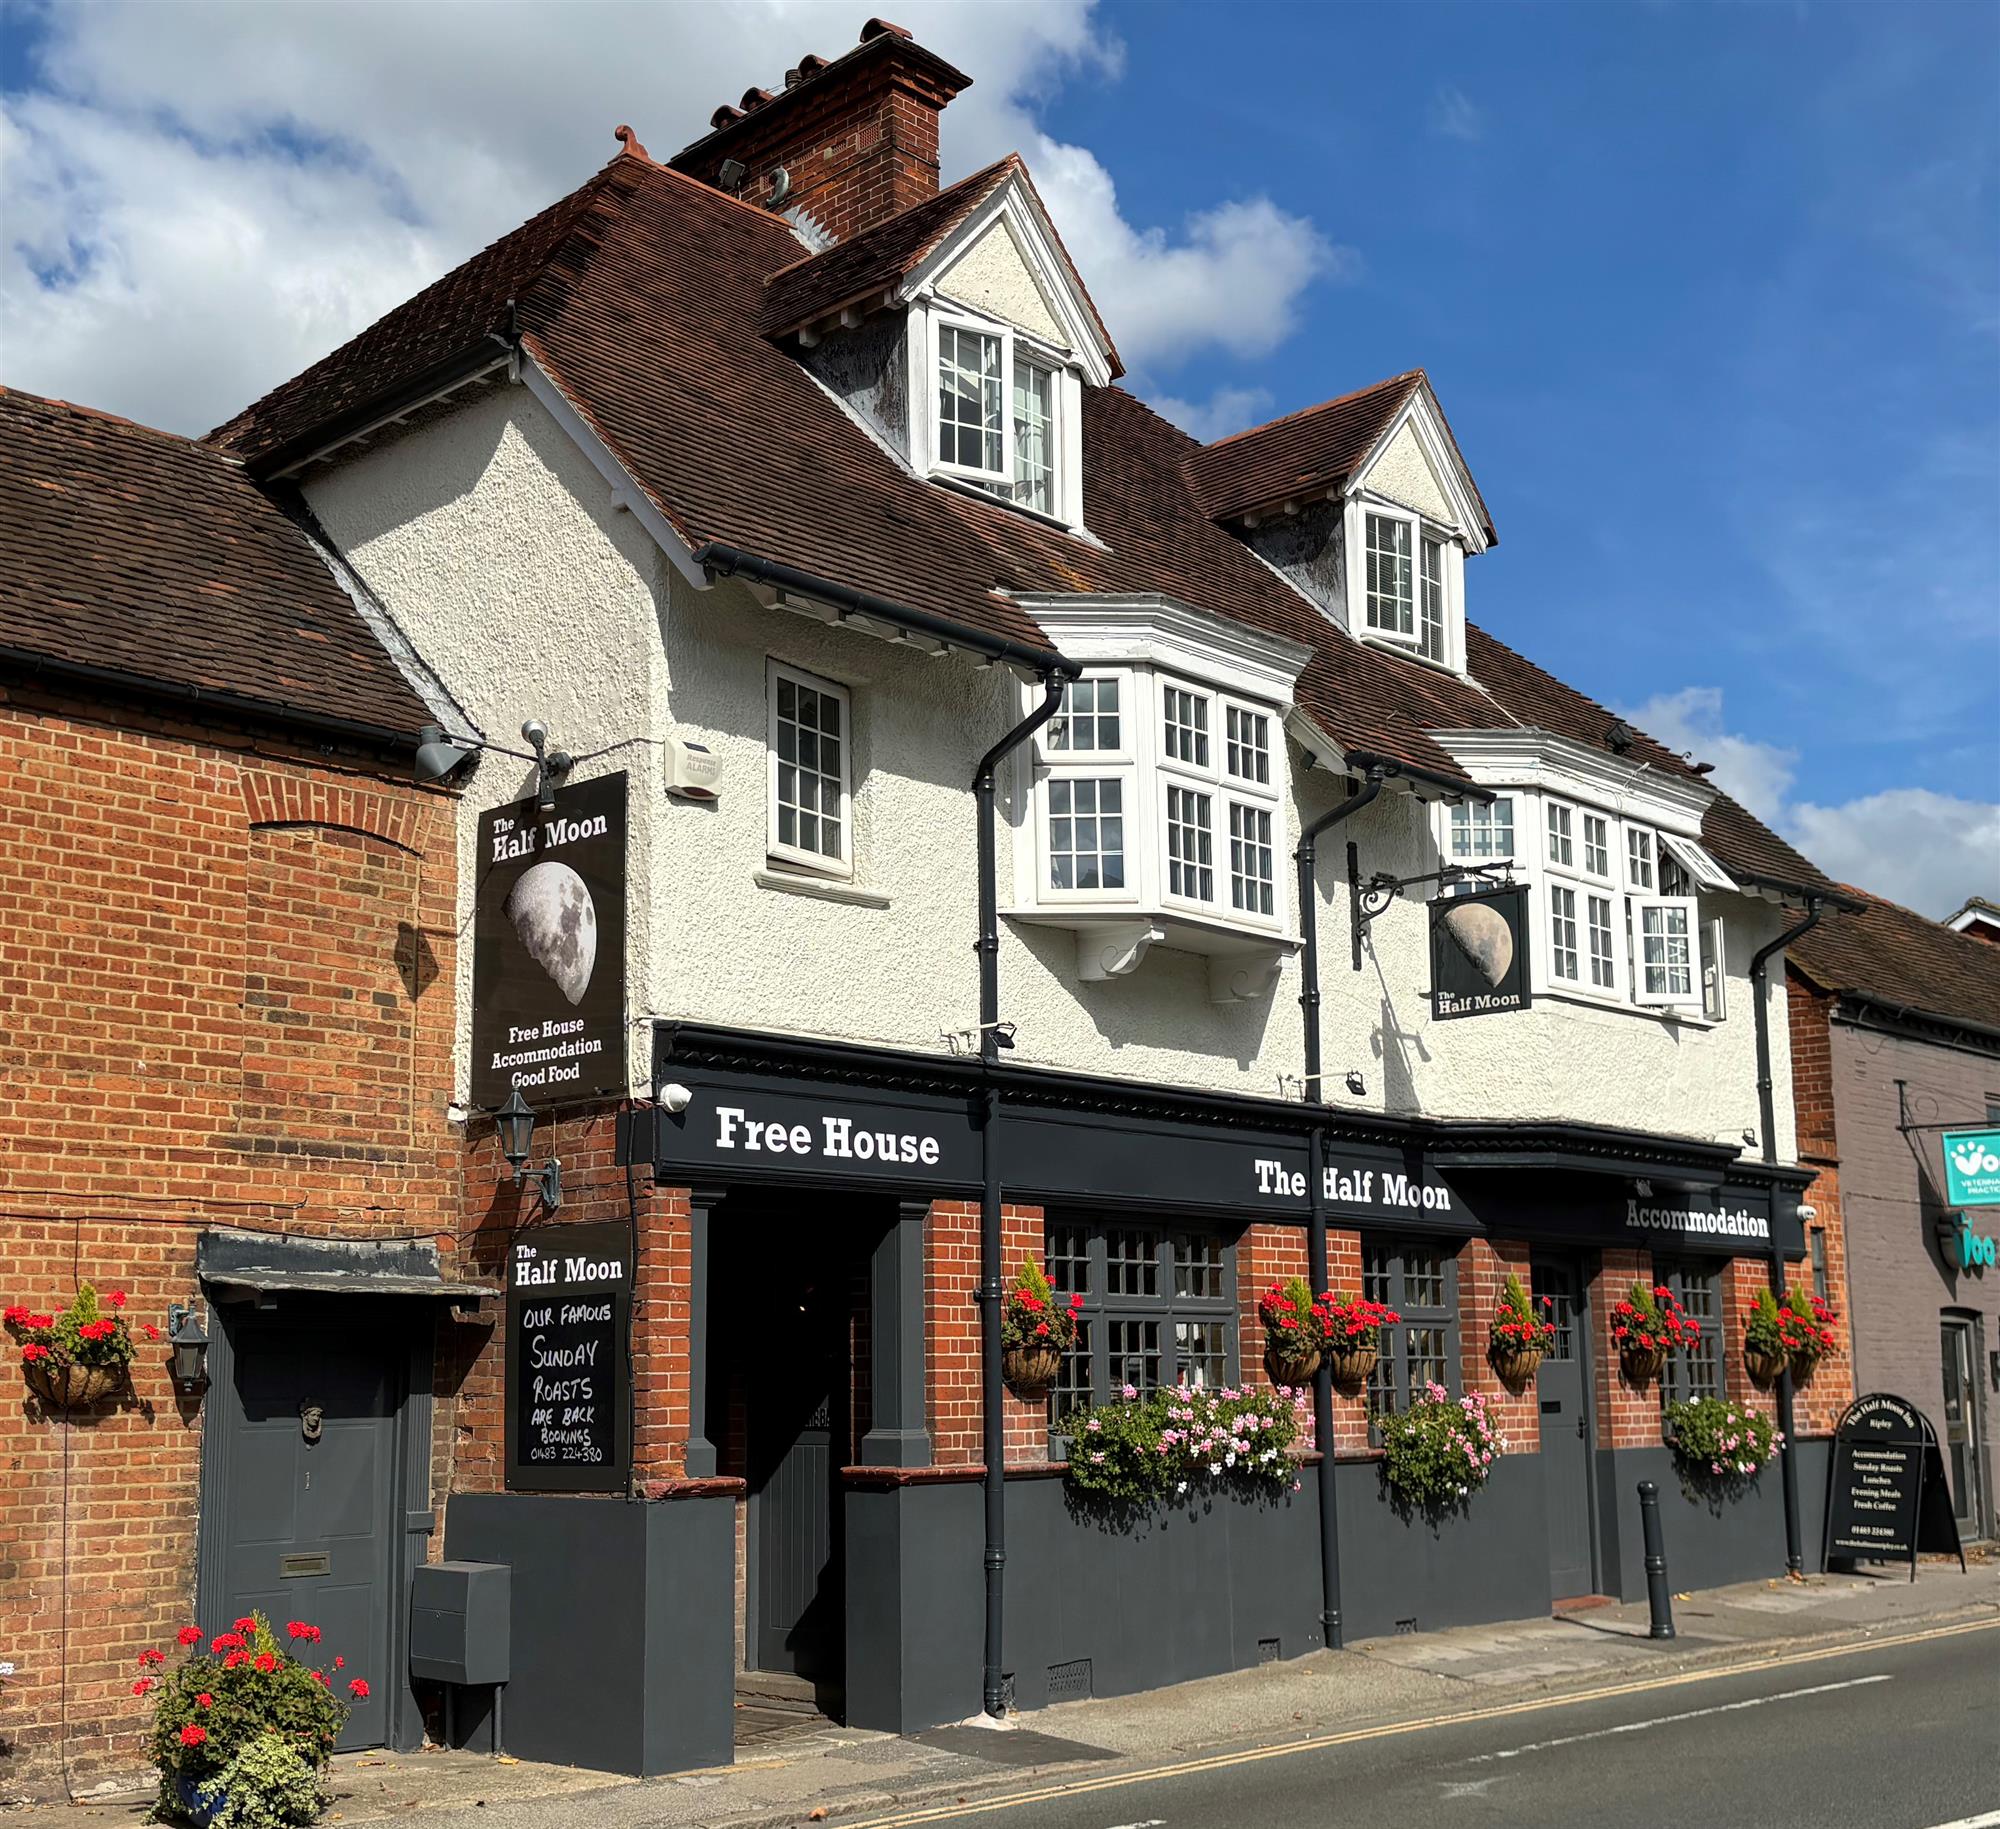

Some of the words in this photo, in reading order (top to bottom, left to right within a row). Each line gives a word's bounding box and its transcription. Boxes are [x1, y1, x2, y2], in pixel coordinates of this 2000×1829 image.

[493, 818, 514, 834] The
[492, 826, 538, 863] Half
[545, 813, 608, 849] Moon
[1438, 991, 1456, 1000] The
[1438, 998, 1472, 1014] Half
[1474, 994, 1520, 1010] Moon
[508, 1023, 540, 1044] Free
[542, 1017, 585, 1038] House
[491, 1038, 602, 1070] Accommodation
[512, 1068, 546, 1089] Good
[548, 1062, 580, 1082] Food
[715, 1106, 812, 1155] Free
[822, 1116, 940, 1165] House
[1254, 1159, 1306, 1197] The
[1322, 1166, 1374, 1204] Half
[1382, 1172, 1451, 1211] Moon
[1626, 1199, 1770, 1238] Accommodation
[516, 1244, 537, 1259] The
[515, 1259, 558, 1286] Half
[564, 1256, 623, 1282] Moon
[523, 1307, 555, 1329] OUR
[560, 1304, 612, 1327] FAMOUS
[530, 1334, 600, 1369] SUNDAY
[532, 1375, 594, 1404] ROASTS
[531, 1407, 553, 1427] ARE
[562, 1406, 596, 1426] BACK
[1846, 1410, 1862, 1426] The
[1860, 1400, 1880, 1414] Half
[1880, 1400, 1904, 1416] Moon
[1869, 1418, 1893, 1430] Ripley
[540, 1427, 592, 1447] BOOKINGS
[530, 1446, 557, 1461] 01483
[562, 1447, 602, 1463] 224380
[1852, 1449, 1907, 1460] Accommodation
[1853, 1462, 1880, 1473] Sunday
[1862, 1474, 1892, 1485] Lunches
[1851, 1486, 1879, 1499] Evening
[1854, 1500, 1872, 1509] Fresh
[1873, 1500, 1897, 1511] Coffee
